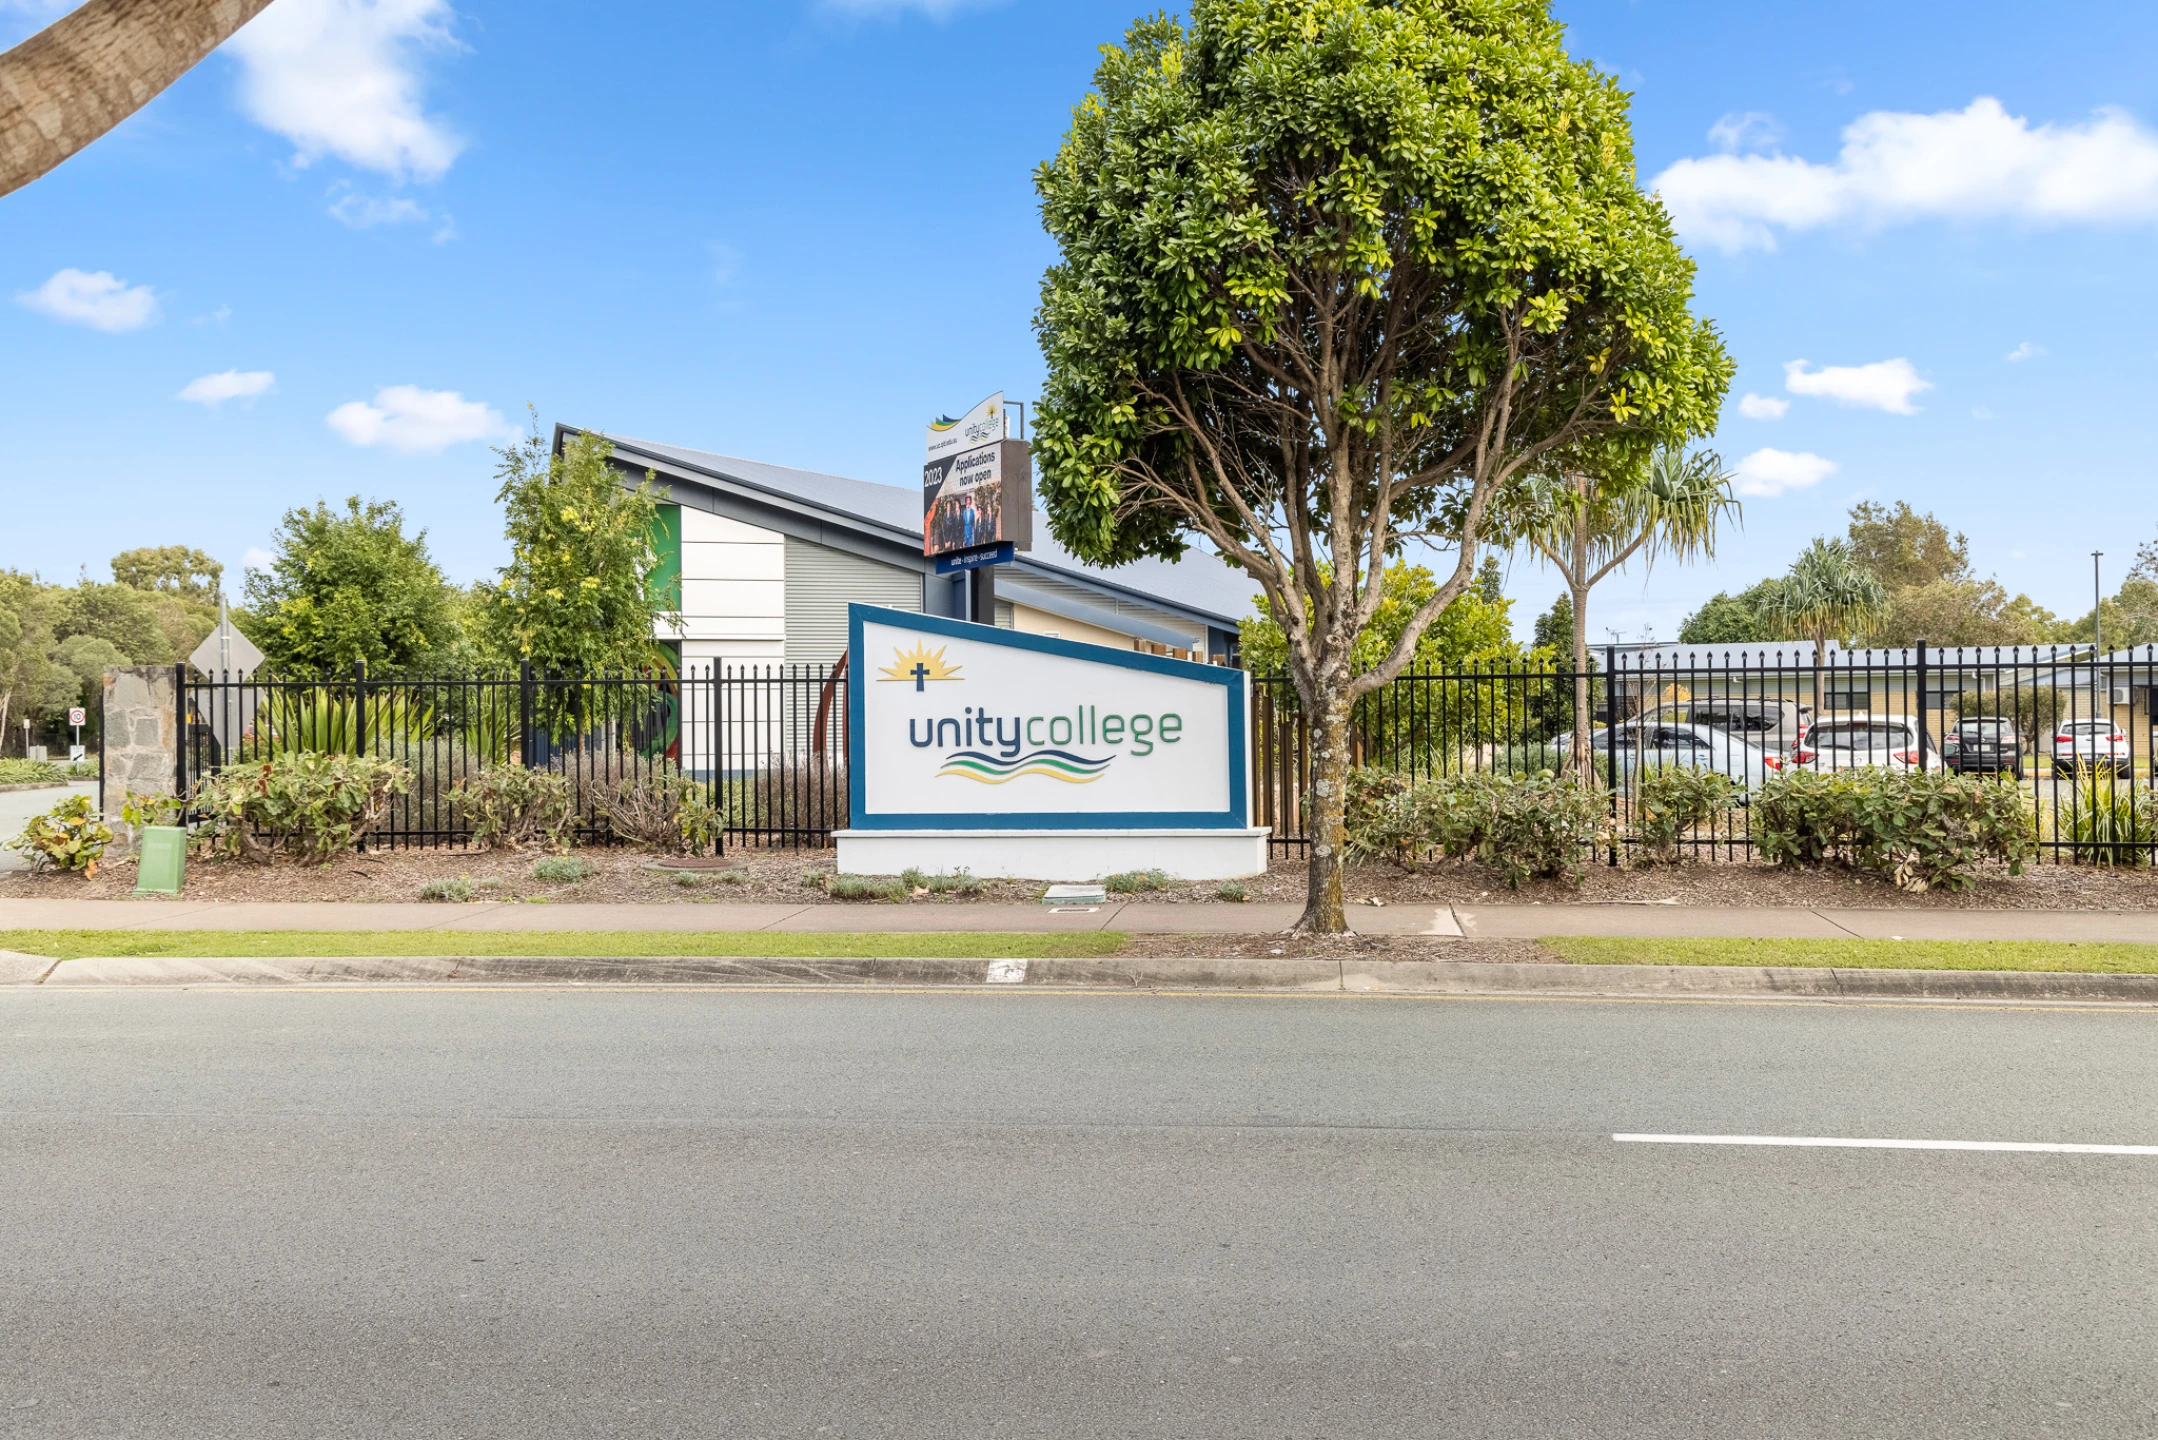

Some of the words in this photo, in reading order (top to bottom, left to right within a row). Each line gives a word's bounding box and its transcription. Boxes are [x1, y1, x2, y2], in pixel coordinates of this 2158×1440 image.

[964, 417, 999, 437] unitycollege
[955, 451, 995, 474] Applications
[924, 466, 942, 487] 2023
[960, 473, 974, 486] now
[974, 469, 991, 485] open
[909, 704, 1183, 757] unitycollege
